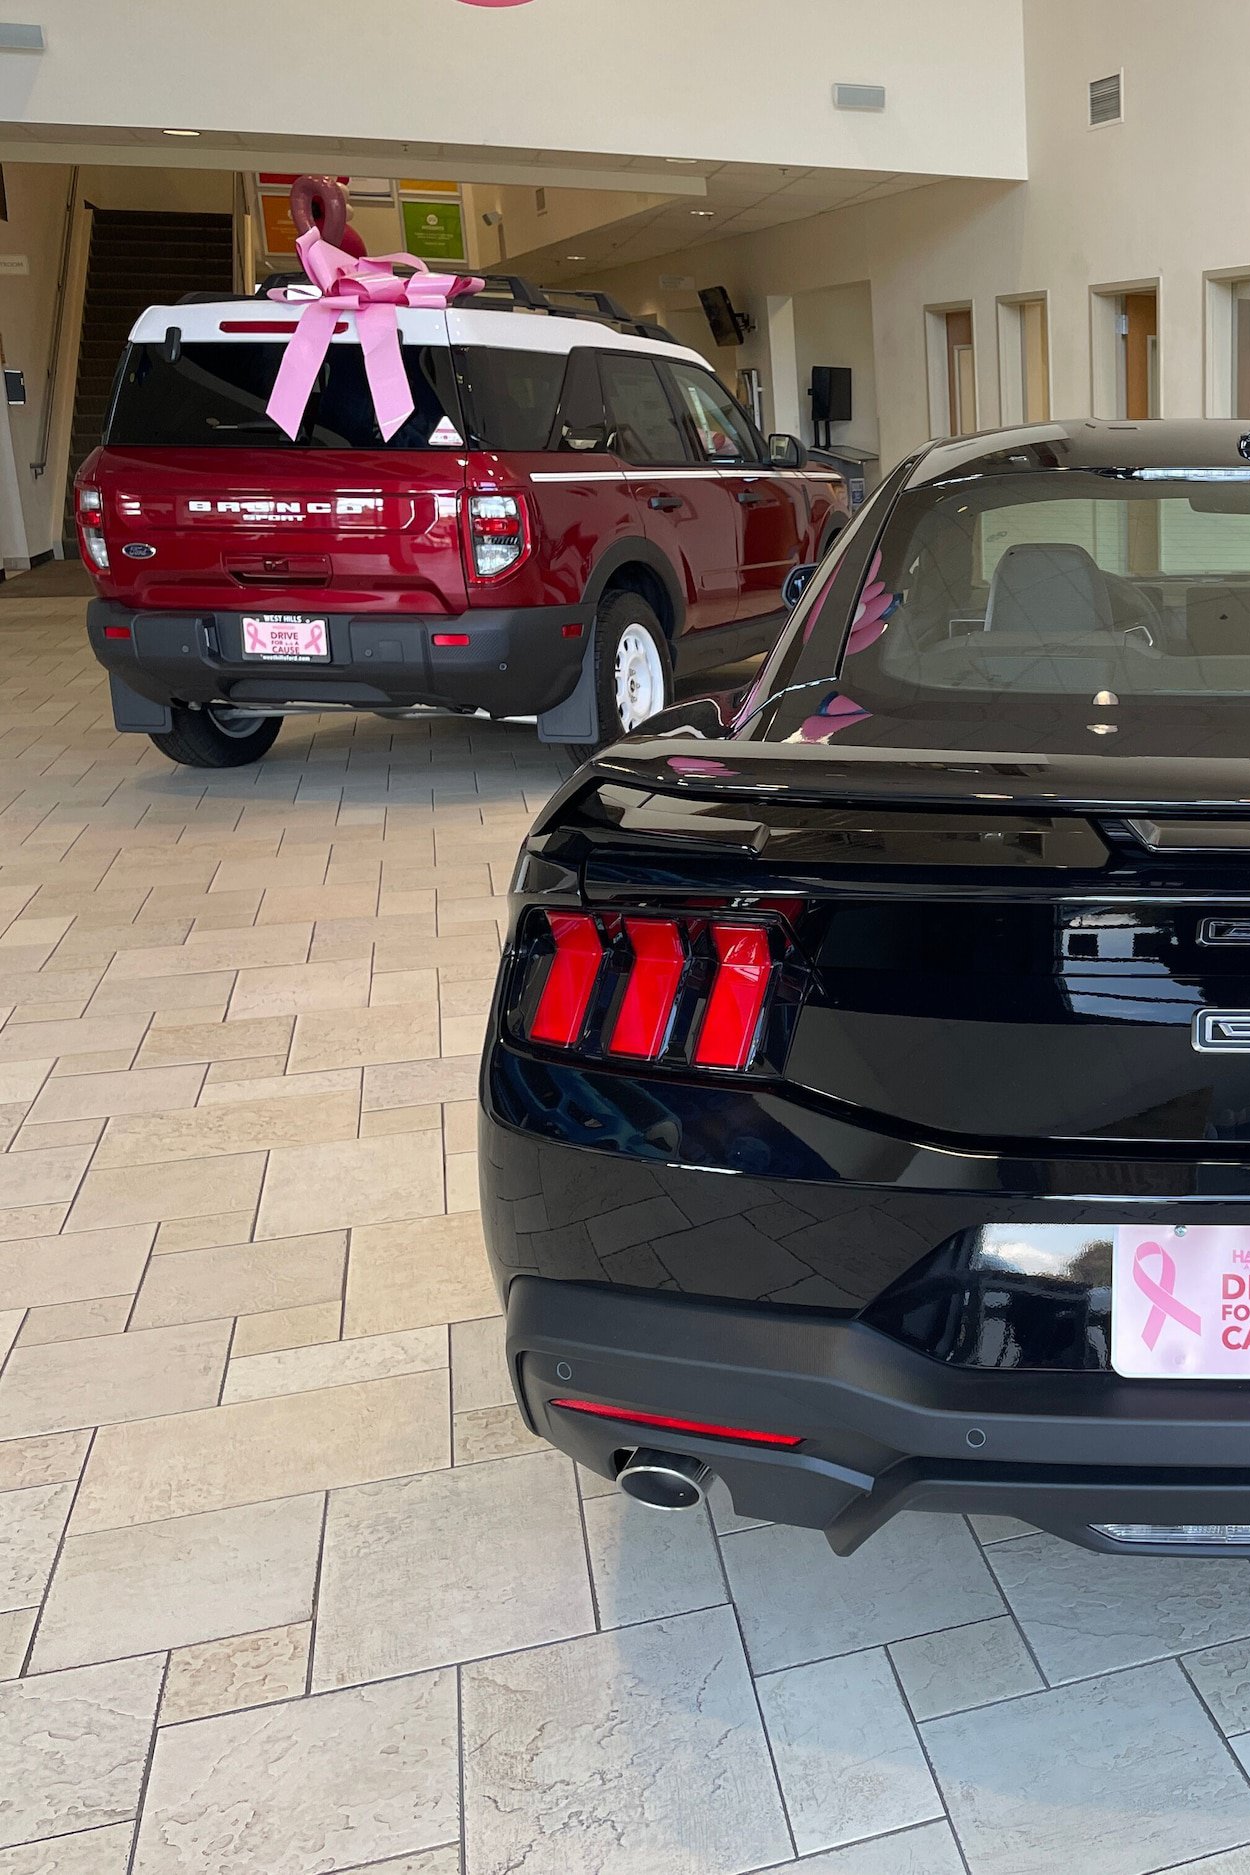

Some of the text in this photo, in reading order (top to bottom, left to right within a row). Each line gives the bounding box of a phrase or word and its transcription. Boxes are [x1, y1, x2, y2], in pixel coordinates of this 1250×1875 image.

[188, 500, 363, 515] BRONCO
[242, 514, 307, 522] SPORT
[263, 614, 302, 623] WEST HILLS
[270, 631, 299, 640] DRIVE
[271, 646, 300, 655] CAUSE
